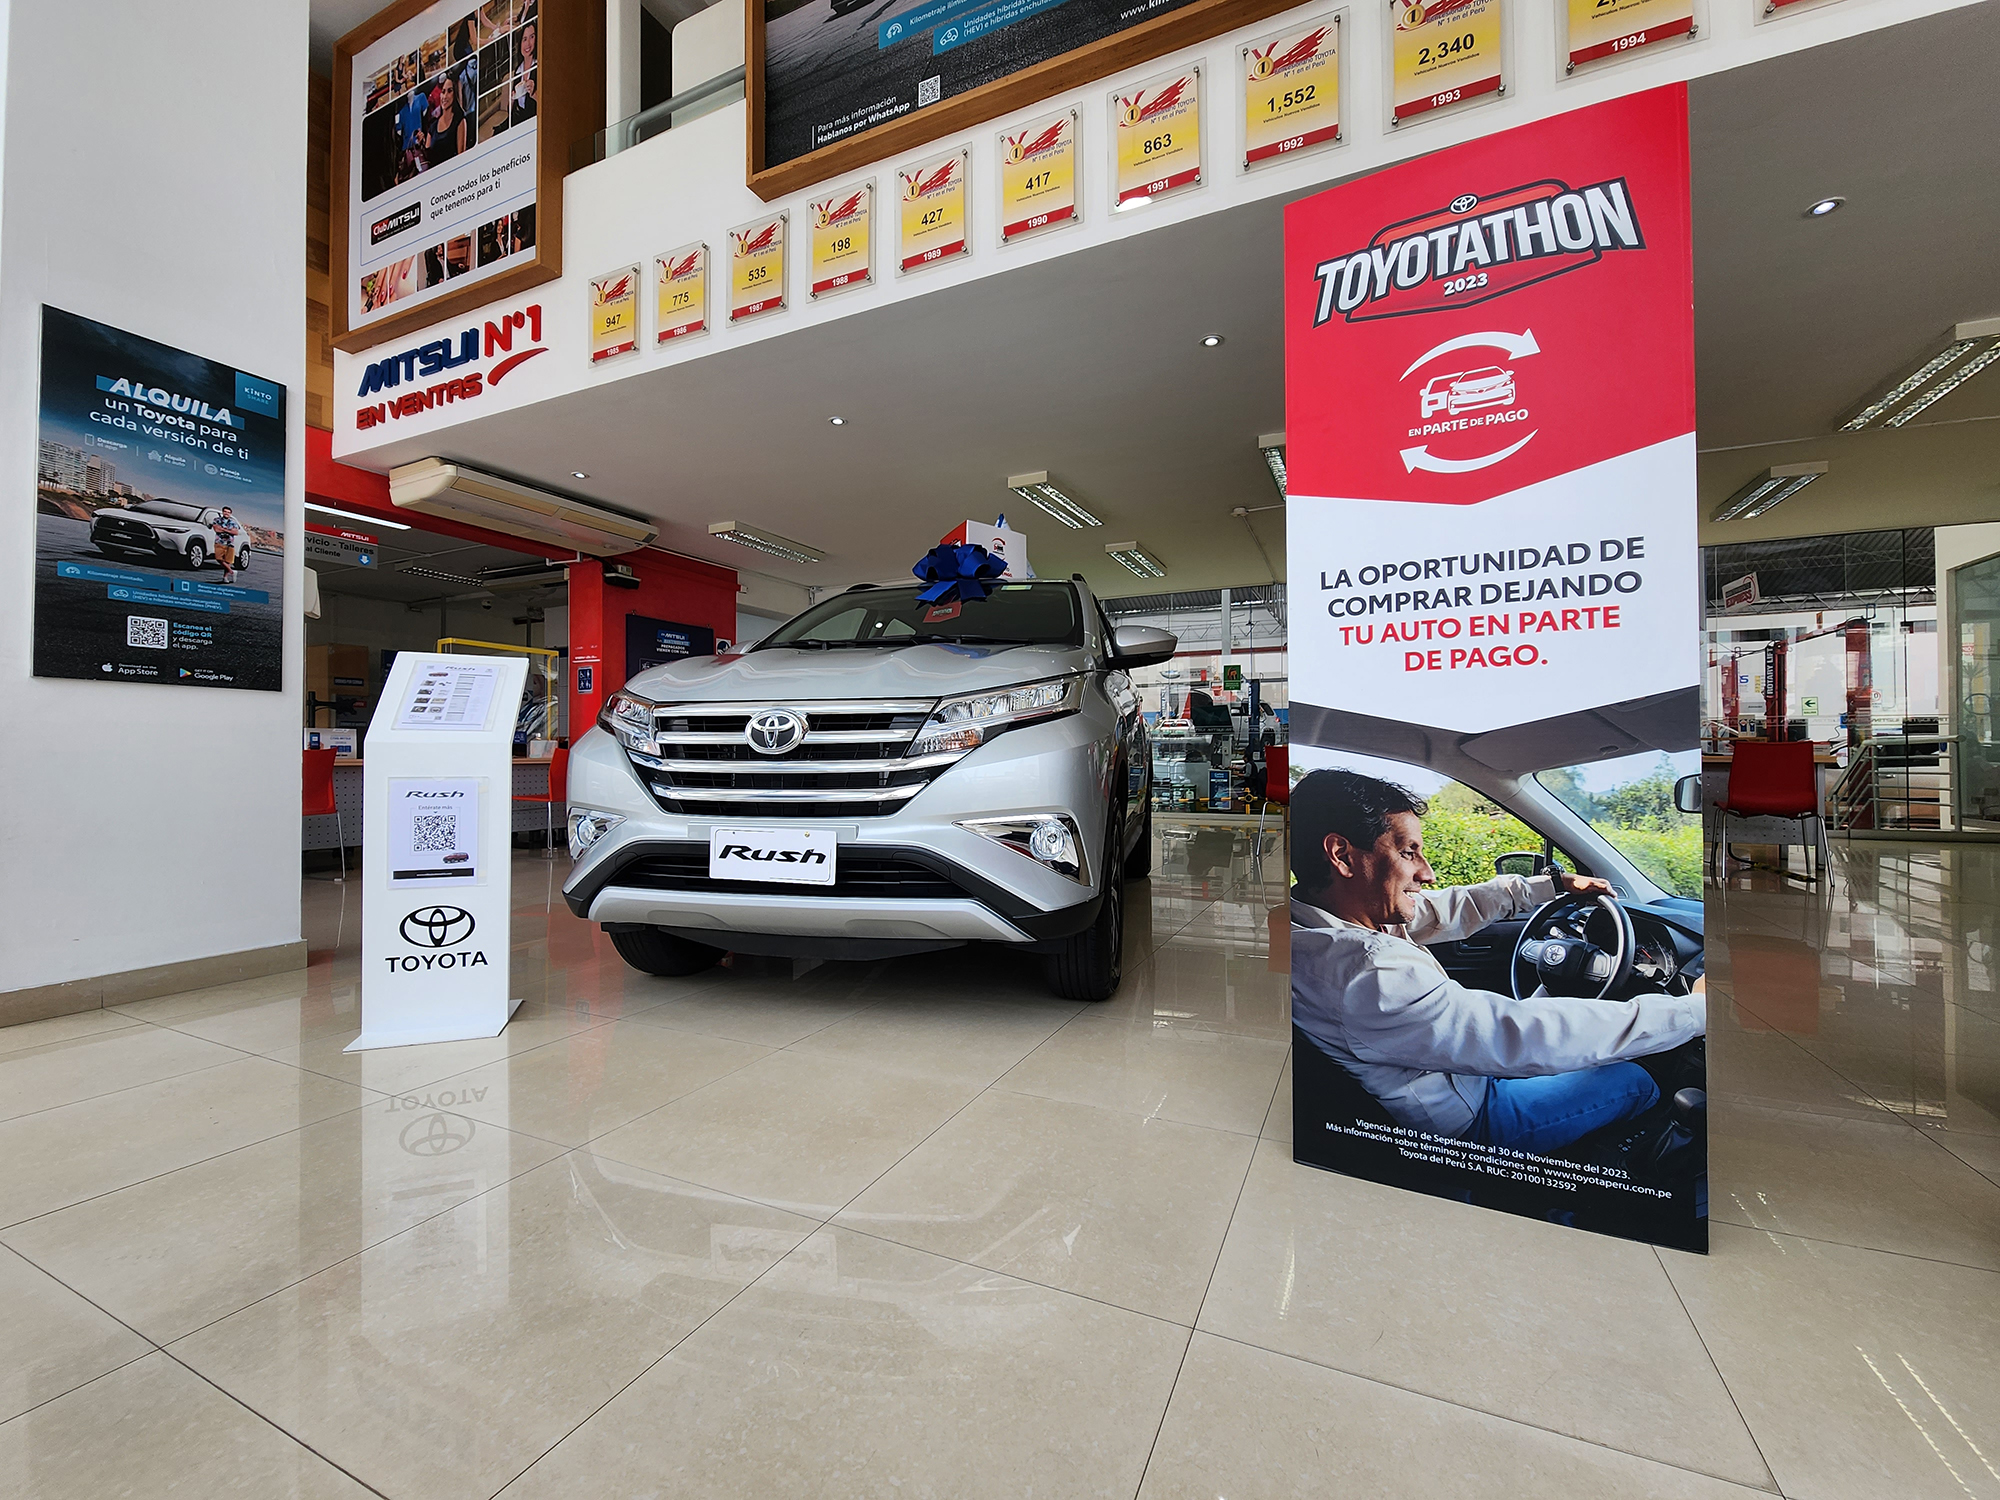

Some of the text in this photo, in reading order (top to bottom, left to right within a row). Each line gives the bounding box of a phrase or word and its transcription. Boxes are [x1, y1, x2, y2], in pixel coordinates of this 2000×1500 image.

[909, 5, 946, 25] Kilometraje
[963, 11, 995, 28] Unidades
[963, 10, 1018, 37] (HEV) e híbridas
[1418, 33, 1475, 65] 2,340
[1611, 32, 1646, 52] 1994
[1314, 48, 1336, 60] TOYOTA
[1267, 84, 1316, 113] 1,552
[1430, 89, 1461, 107] 1993
[817, 96, 897, 133] Para más información
[817, 102, 910, 144] Hablanos por WhatsApp
[1144, 133, 1172, 155] 863
[1277, 136, 1304, 152] 1992
[430, 153, 532, 206] Conoce todos los beneficios
[1025, 171, 1051, 191] 417
[1147, 179, 1169, 194] 1991
[430, 178, 501, 220] que tenemos para ti
[387, 207, 420, 229] MITSUI
[921, 207, 944, 226] 427
[1027, 214, 1048, 229] 1990
[830, 237, 851, 253] 198
[923, 248, 942, 262] 1989
[1316, 182, 1640, 325] TOYOTATHON
[748, 266, 767, 282] 535
[832, 275, 849, 286] 1988
[1443, 273, 1489, 296] 2023
[672, 291, 690, 306] 775
[749, 303, 764, 313] 1987
[605, 314, 622, 328] 947
[357, 327, 480, 398] MITSUI
[109, 377, 232, 426] ALQUILA
[356, 372, 483, 431] EN VENTAS
[105, 398, 237, 442] un Toyota para
[1408, 408, 1529, 437] EN PARTE DE PAGO
[89, 410, 249, 460] cada versión de ti
[341, 531, 370, 542] MITSUI
[314, 547, 341, 557] Cliente
[339, 541, 374, 555] Talleres
[1320, 536, 1646, 591] LA OPORTUNIDAD DE
[1328, 571, 1643, 618] COMPRAR DEJANDO
[173, 622, 203, 631] Escanea
[173, 629, 199, 638] código
[1339, 605, 1621, 645] TU AUTO EN PARTE
[178, 637, 213, 646] descarga
[1404, 644, 1549, 671] DE PAGO.
[118, 667, 136, 676] App
[194, 672, 218, 681] Google
[1766, 648, 1774, 695] ROTARY LIFT
[405, 789, 465, 799] Rush
[719, 844, 827, 865] Rush
[385, 951, 488, 973] TOYOTA
[1355, 1118, 1631, 1180] Vigencia del 01 de Septiembre al 30 de Noviembre del 2023.
[1325, 1122, 1673, 1199] Más información sobre términos y condiciones en www.toyotaperu.com.pe
[1399, 1147, 1577, 1193] Toyota del Perú S.A. RUC: 20100132592
